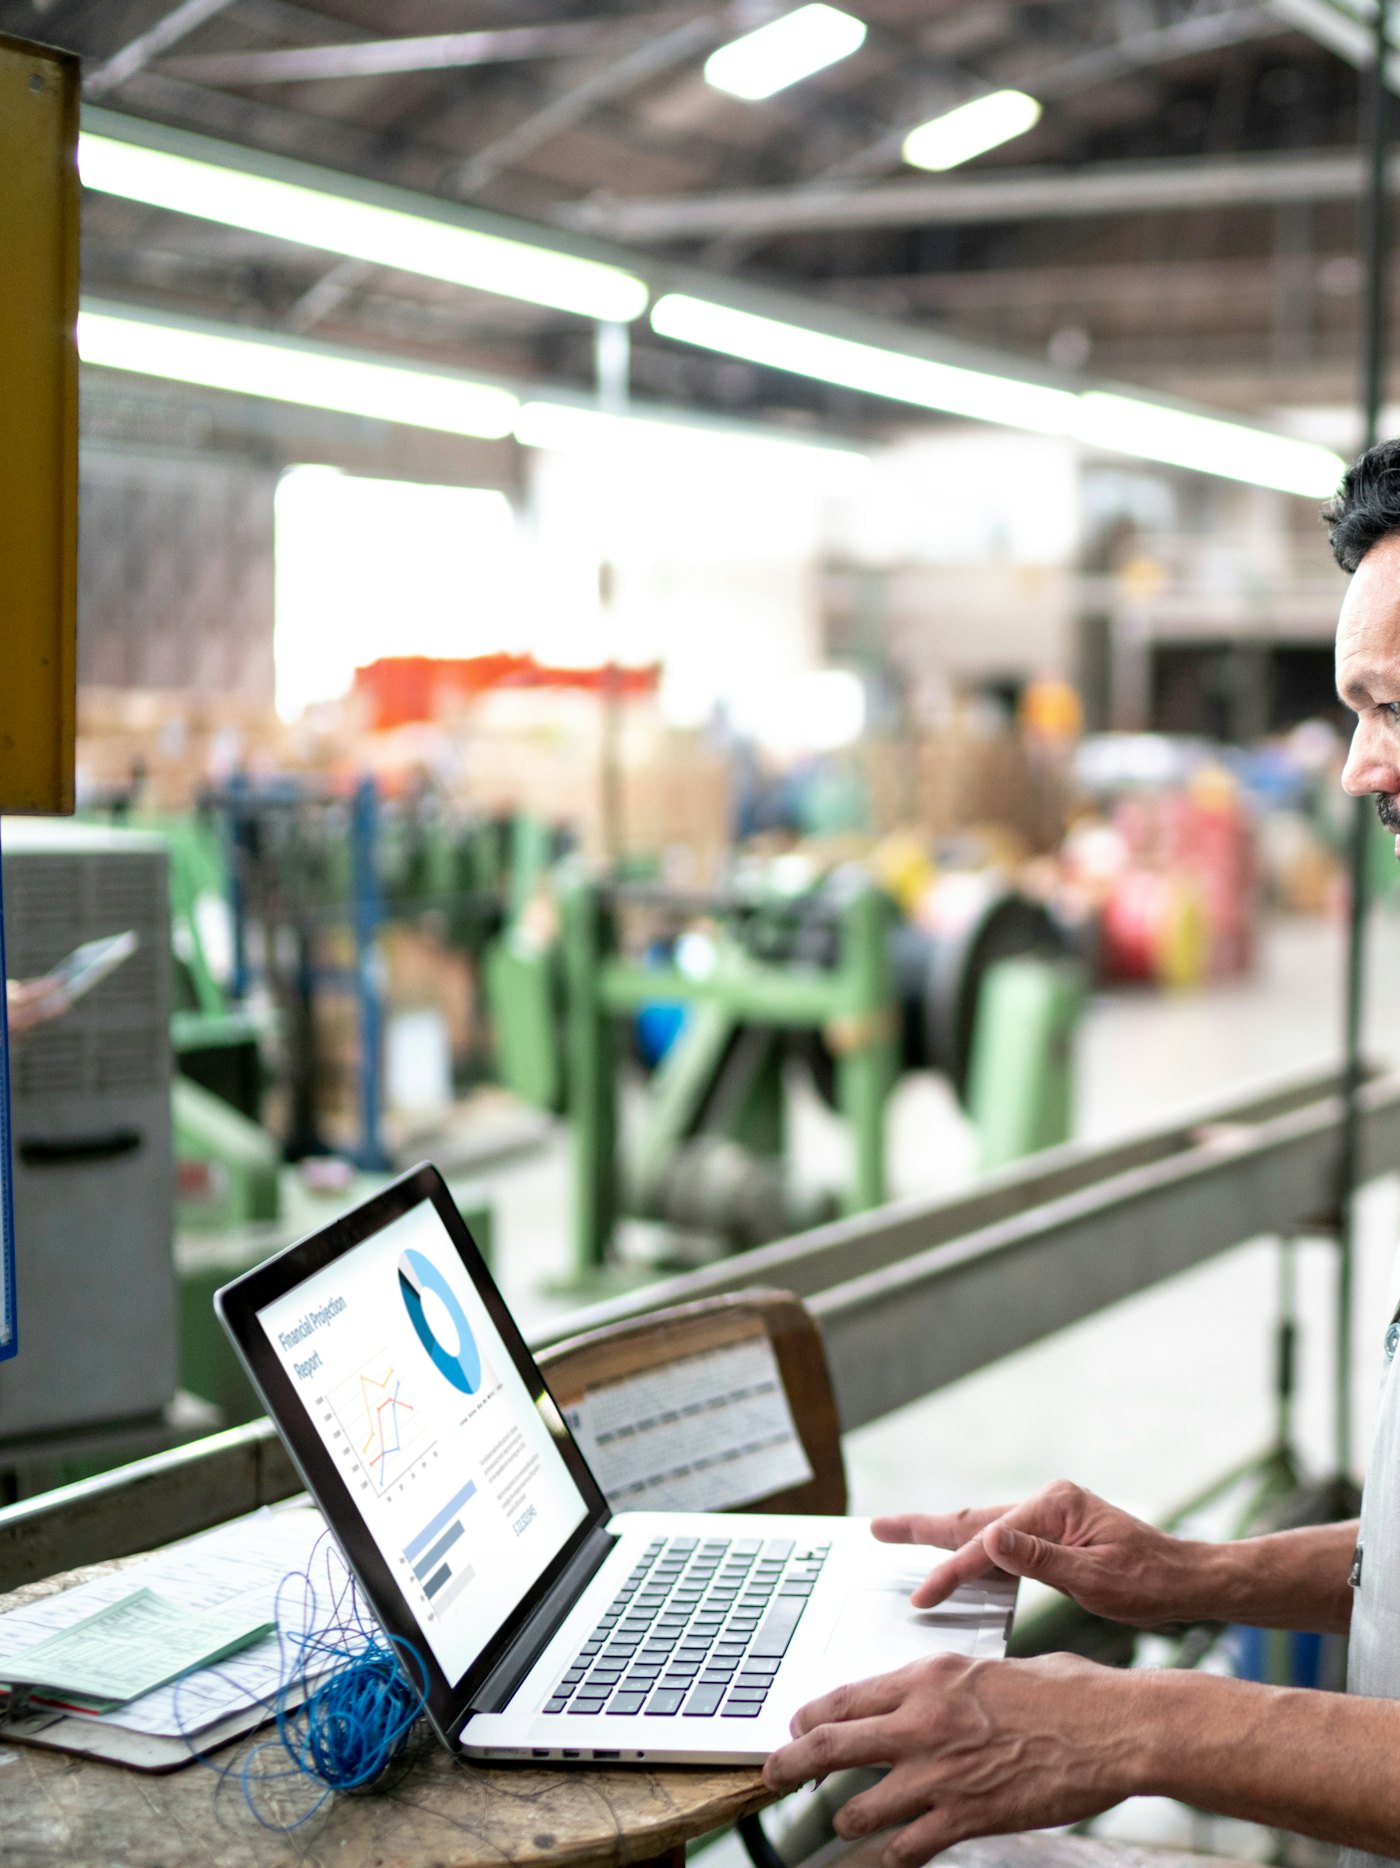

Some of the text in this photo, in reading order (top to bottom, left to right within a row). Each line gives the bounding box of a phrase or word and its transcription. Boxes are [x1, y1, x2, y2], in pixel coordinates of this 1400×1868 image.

[278, 1296, 347, 1352] Financial Projection
[293, 1350, 323, 1380] Report
